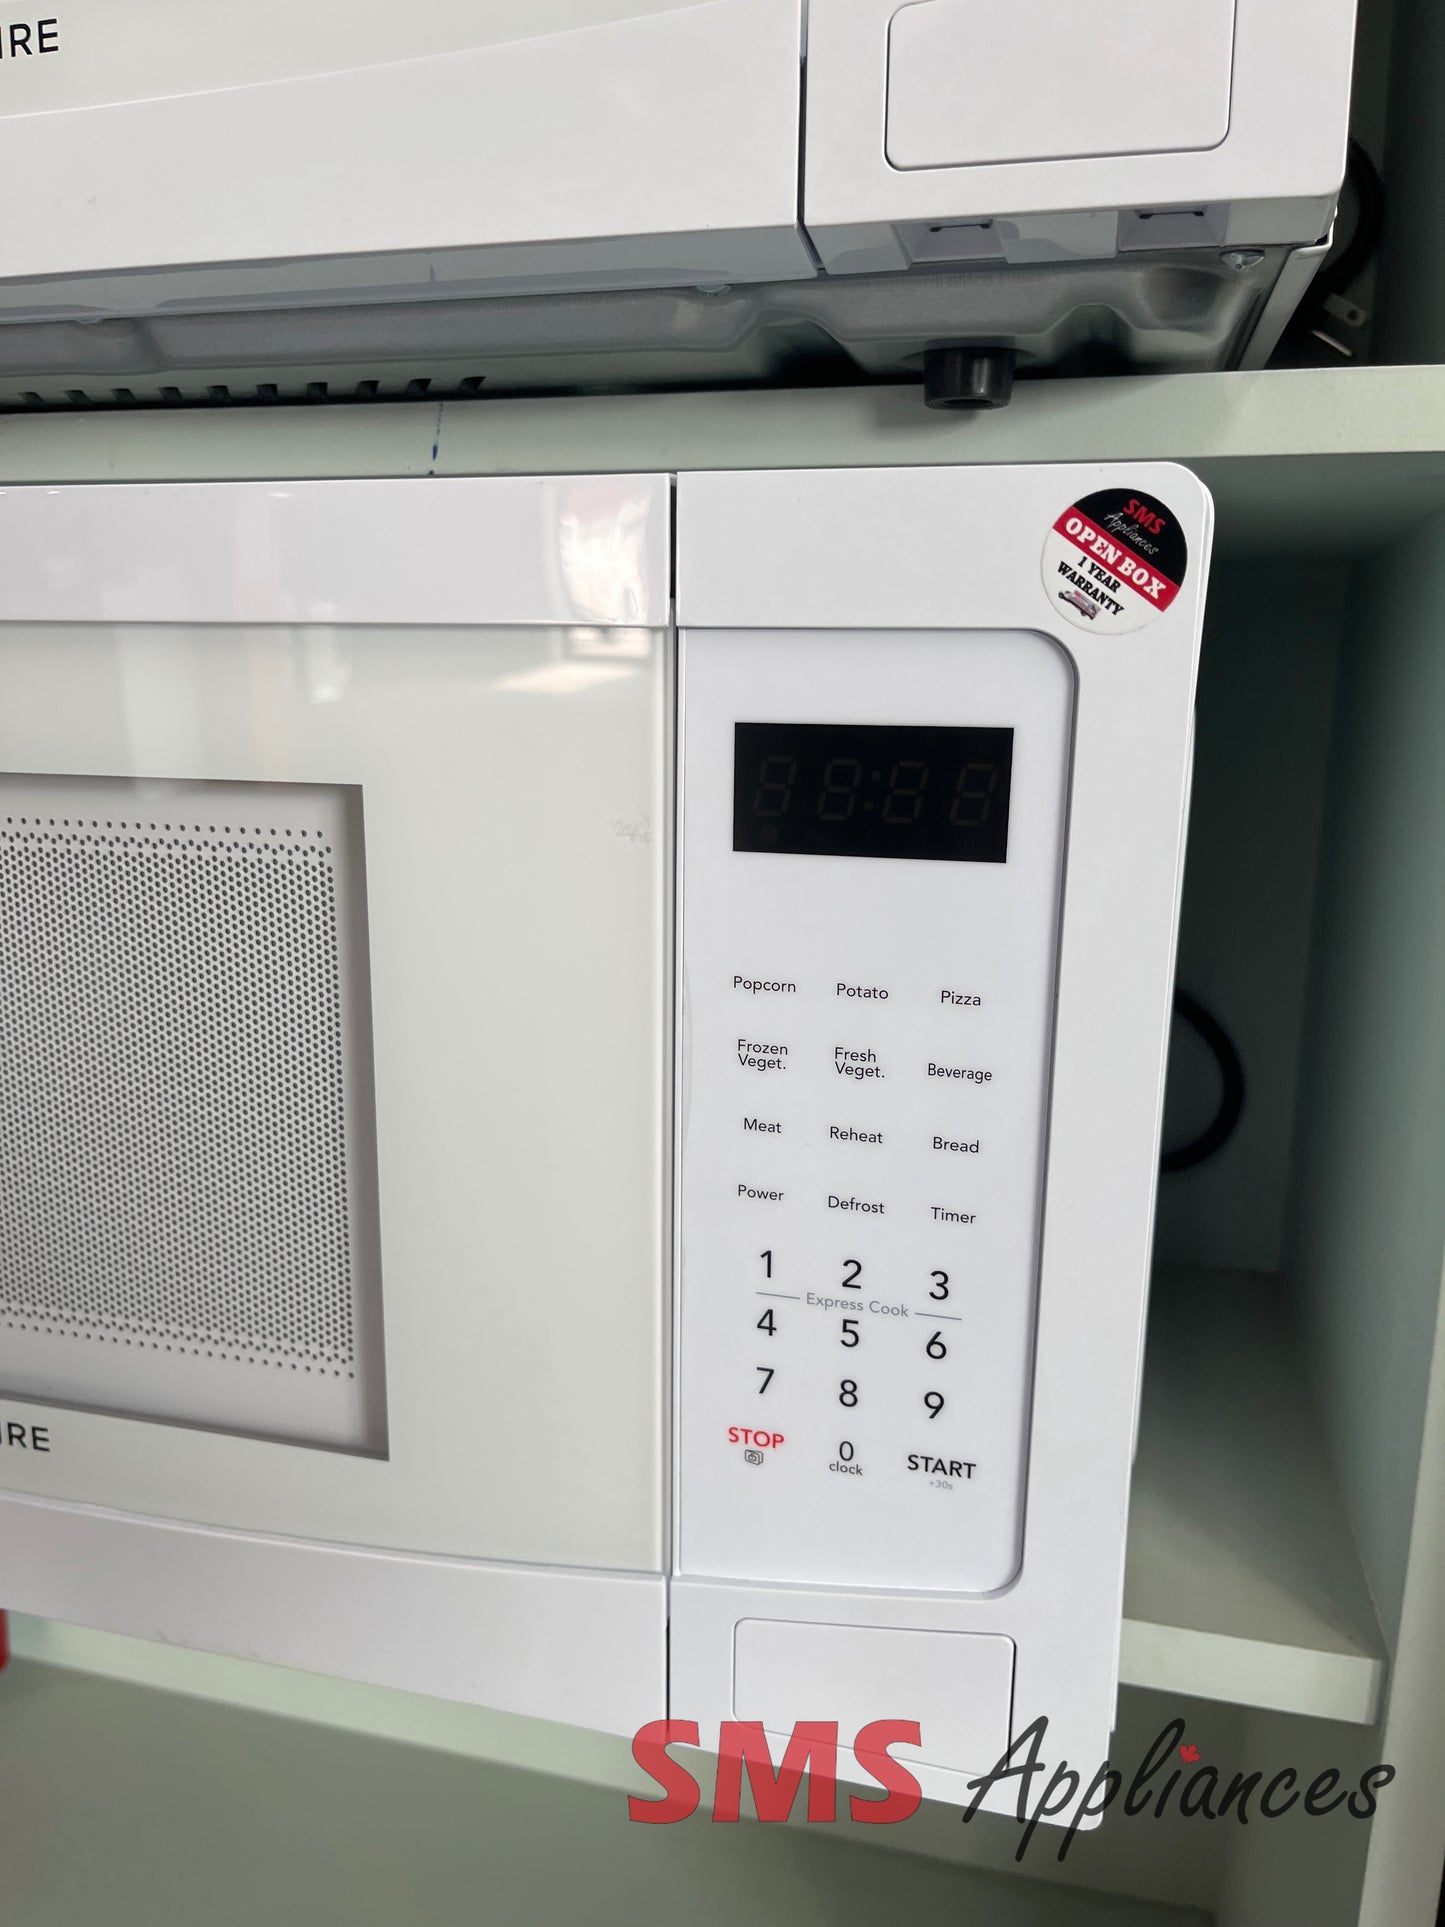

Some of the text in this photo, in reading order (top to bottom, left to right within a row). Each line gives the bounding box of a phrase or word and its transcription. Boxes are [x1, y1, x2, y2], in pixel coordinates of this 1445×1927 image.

[1123, 499, 1166, 534] SMS
[1104, 512, 1159, 555] Appliances
[1065, 517, 1166, 599] OPEN BOX
[1078, 556, 1121, 593] 1 YEAR
[1058, 561, 1124, 615] WARRANTY
[734, 976, 796, 994] Popcorn
[837, 983, 888, 999] Potato
[941, 990, 981, 1006] Pizza
[738, 1039, 788, 1054] Frozen
[835, 1047, 876, 1062] Fresh
[738, 1054, 786, 1071] Veget.
[835, 1062, 885, 1079] Veget.
[928, 1063, 992, 1084] Beverage
[744, 1118, 781, 1133] Meat
[830, 1126, 883, 1144] Reheat
[933, 1136, 979, 1153] Bread
[738, 1184, 784, 1200] Power
[828, 1196, 884, 1214] Defrost
[931, 1207, 976, 1224] Timer
[760, 1250, 772, 1278] 1
[842, 1259, 862, 1289] 2
[929, 1271, 949, 1300] 3
[806, 1293, 908, 1317] Express Cook
[757, 1309, 777, 1336] 4
[841, 1319, 859, 1348] 5
[926, 1331, 947, 1360] 6
[757, 1367, 774, 1394] 7
[839, 1379, 858, 1407] 8
[924, 1391, 944, 1419] 9
[728, 1427, 784, 1448] STOP
[839, 1441, 854, 1461] 0
[829, 1461, 862, 1476] clock
[907, 1455, 976, 1478] START
